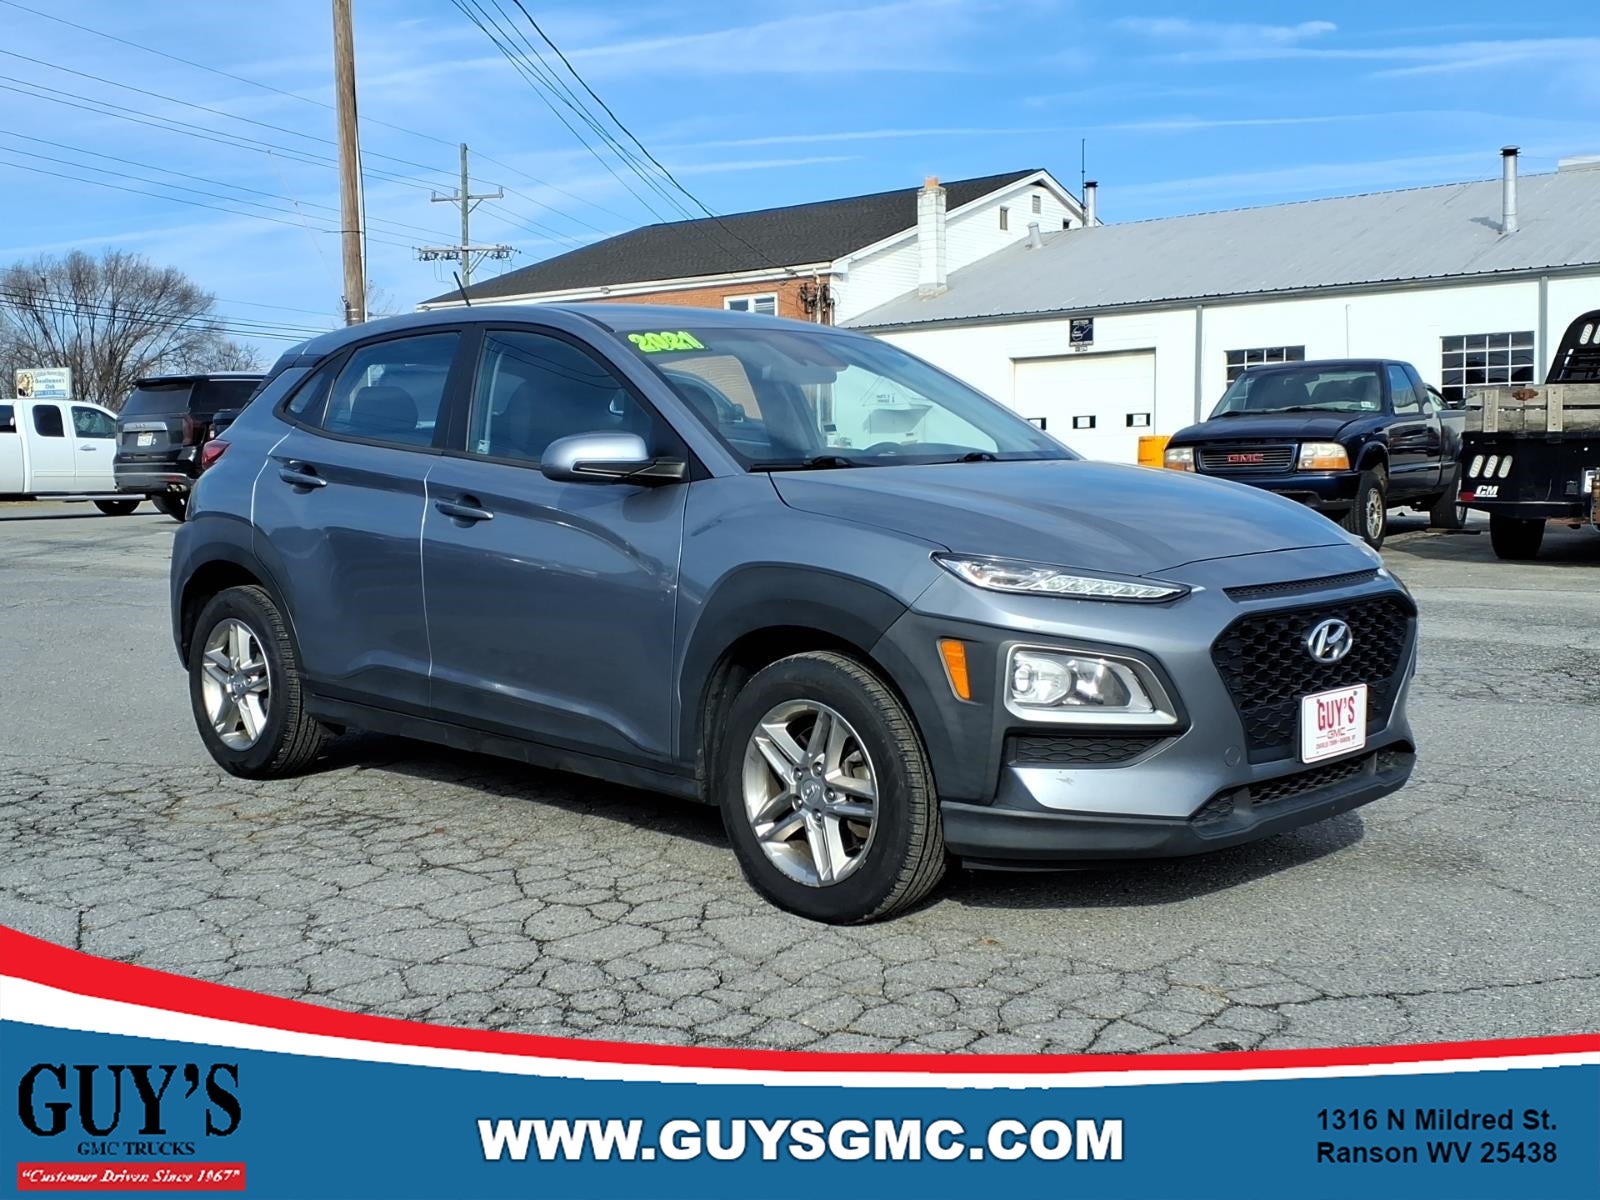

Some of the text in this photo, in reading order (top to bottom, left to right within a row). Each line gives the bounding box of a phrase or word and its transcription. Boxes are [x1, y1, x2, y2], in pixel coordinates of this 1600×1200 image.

[1227, 454, 1264, 463] GMC
[1474, 484, 1499, 498] CM
[1317, 696, 1355, 731] GUY'S
